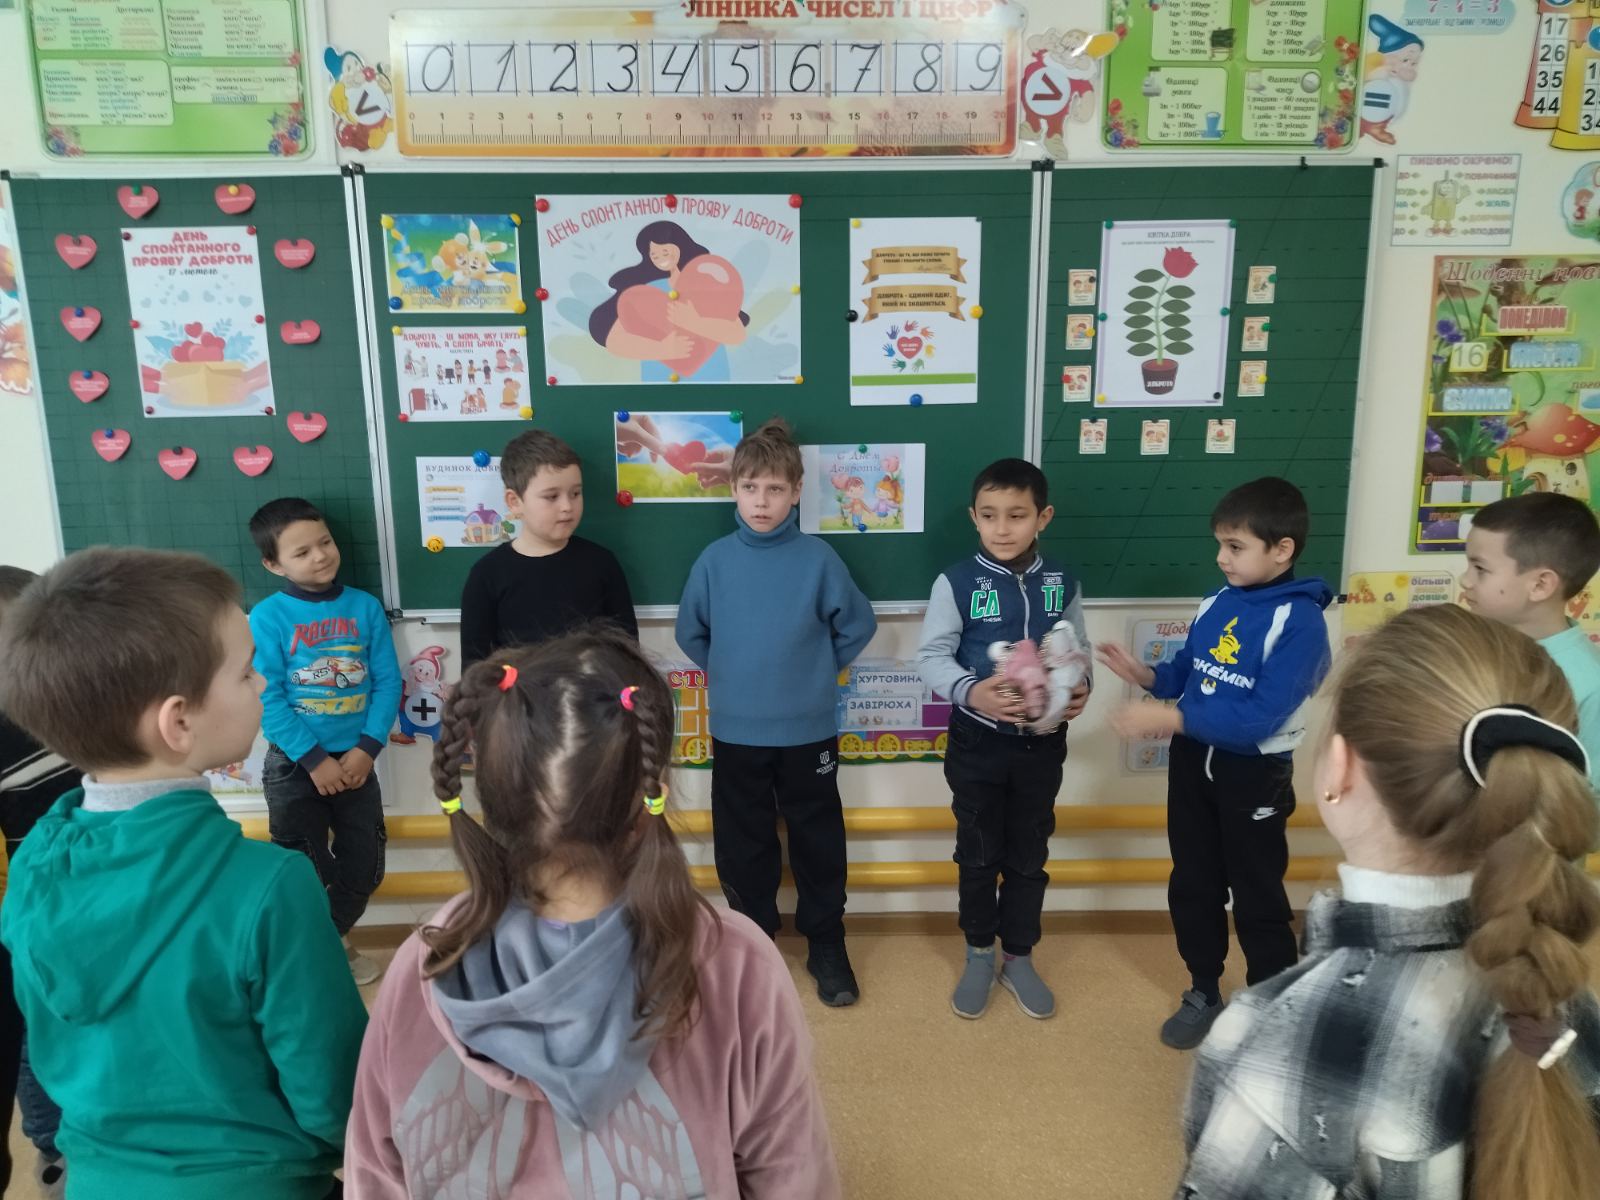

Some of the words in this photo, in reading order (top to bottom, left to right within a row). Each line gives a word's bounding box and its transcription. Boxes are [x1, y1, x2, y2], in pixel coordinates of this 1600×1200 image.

[685, 0, 799, 18] ЛІНІЙКА
[807, 0, 894, 18] ЧИСЕЛ
[918, 0, 991, 21] ЦИФР
[1544, 17, 1569, 35] 17
[1540, 44, 1566, 62] 26
[422, 44, 454, 92] 0
[497, 44, 514, 92] 1
[550, 43, 578, 92] 2
[607, 43, 638, 92] 3
[662, 44, 699, 93] 4
[724, 43, 760, 92] 5
[789, 43, 820, 92] 6
[850, 43, 881, 92] 7
[912, 43, 942, 92] 8
[969, 43, 1001, 92] 9
[1537, 71, 1563, 88] 35
[1533, 97, 1560, 115] 44
[703, 111, 715, 121] 10
[732, 111, 743, 121] 11
[761, 111, 773, 121] 12
[790, 111, 802, 121] 13
[848, 111, 860, 121] 15
[878, 111, 890, 121] 16
[906, 111, 918, 121] 17
[936, 111, 947, 121] 18
[964, 111, 977, 121] 19
[993, 111, 1006, 121] 20
[545, 221, 580, 248] ДЕНЬ
[682, 196, 732, 220] ПРОЯВУ
[733, 207, 796, 245] ДОБРОТИ
[171, 231, 209, 244] ДЕНЬ
[140, 242, 241, 255] СПОНТАННОГО
[132, 255, 184, 267] ПРОЯВУ
[188, 254, 254, 267] ДОБРОТИ
[1455, 345, 1485, 368] 16
[425, 465, 472, 473] БУДИНОК
[474, 465, 501, 473] ДОБР
[290, 617, 359, 657] RACING
[858, 674, 923, 684] ХУРТОВИНА
[850, 701, 912, 710] ЗАВІРЮХА
